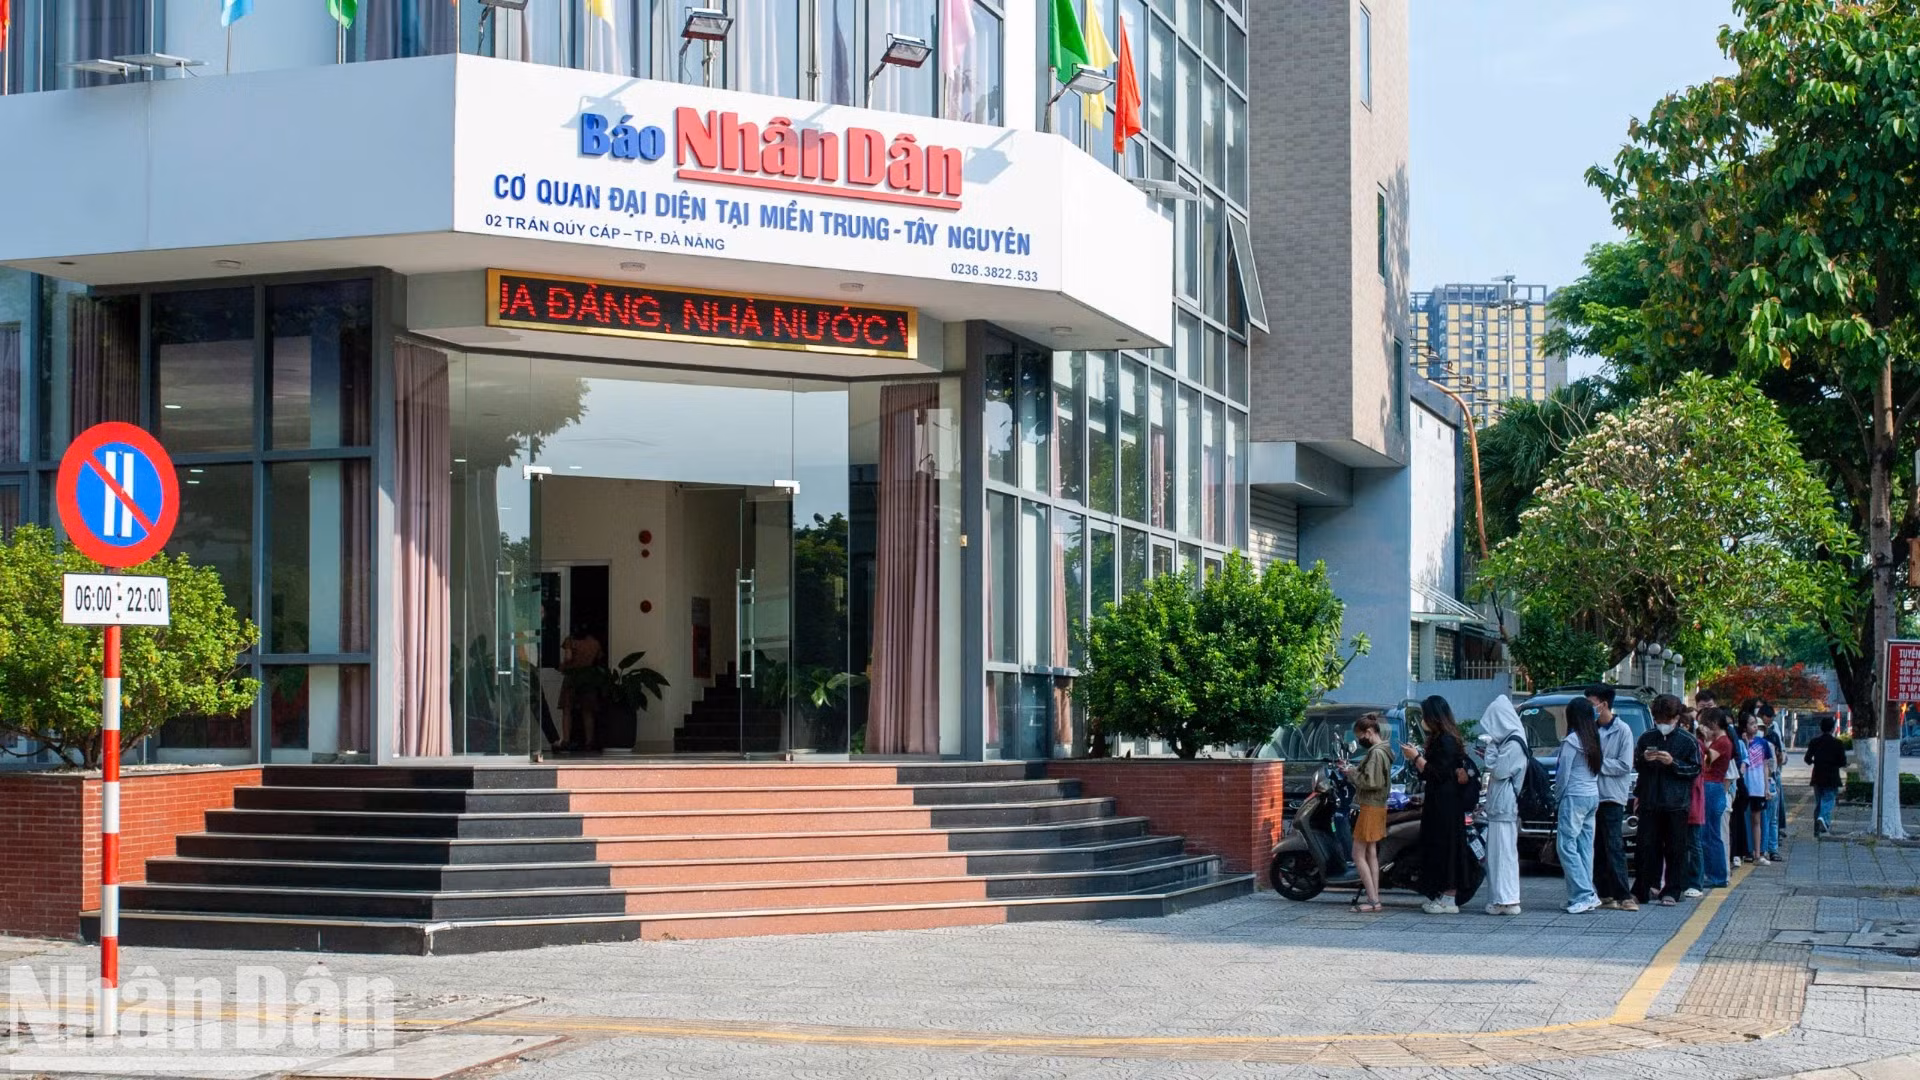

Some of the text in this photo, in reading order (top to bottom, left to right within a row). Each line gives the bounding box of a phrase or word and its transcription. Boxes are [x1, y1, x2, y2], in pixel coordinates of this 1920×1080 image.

[580, 106, 963, 197] Báo Nhân Dân
[485, 214, 502, 228] 02
[660, 230, 680, 246] ĐÀ
[493, 173, 527, 200] CƠ
[536, 179, 601, 210] QUAN
[608, 187, 647, 218] ĐẠI
[655, 190, 706, 224] DIỆN
[715, 199, 750, 229] TẠI
[948, 225, 1031, 256] NGUYÊN
[951, 263, 1038, 283] 0236.3822.533
[546, 282, 671, 334] ĐẢNG,
[683, 297, 763, 337] NHÀ
[773, 304, 889, 346] NƯỚC
[75, 585, 112, 612] 06:00
[127, 587, 163, 612] 22:00
